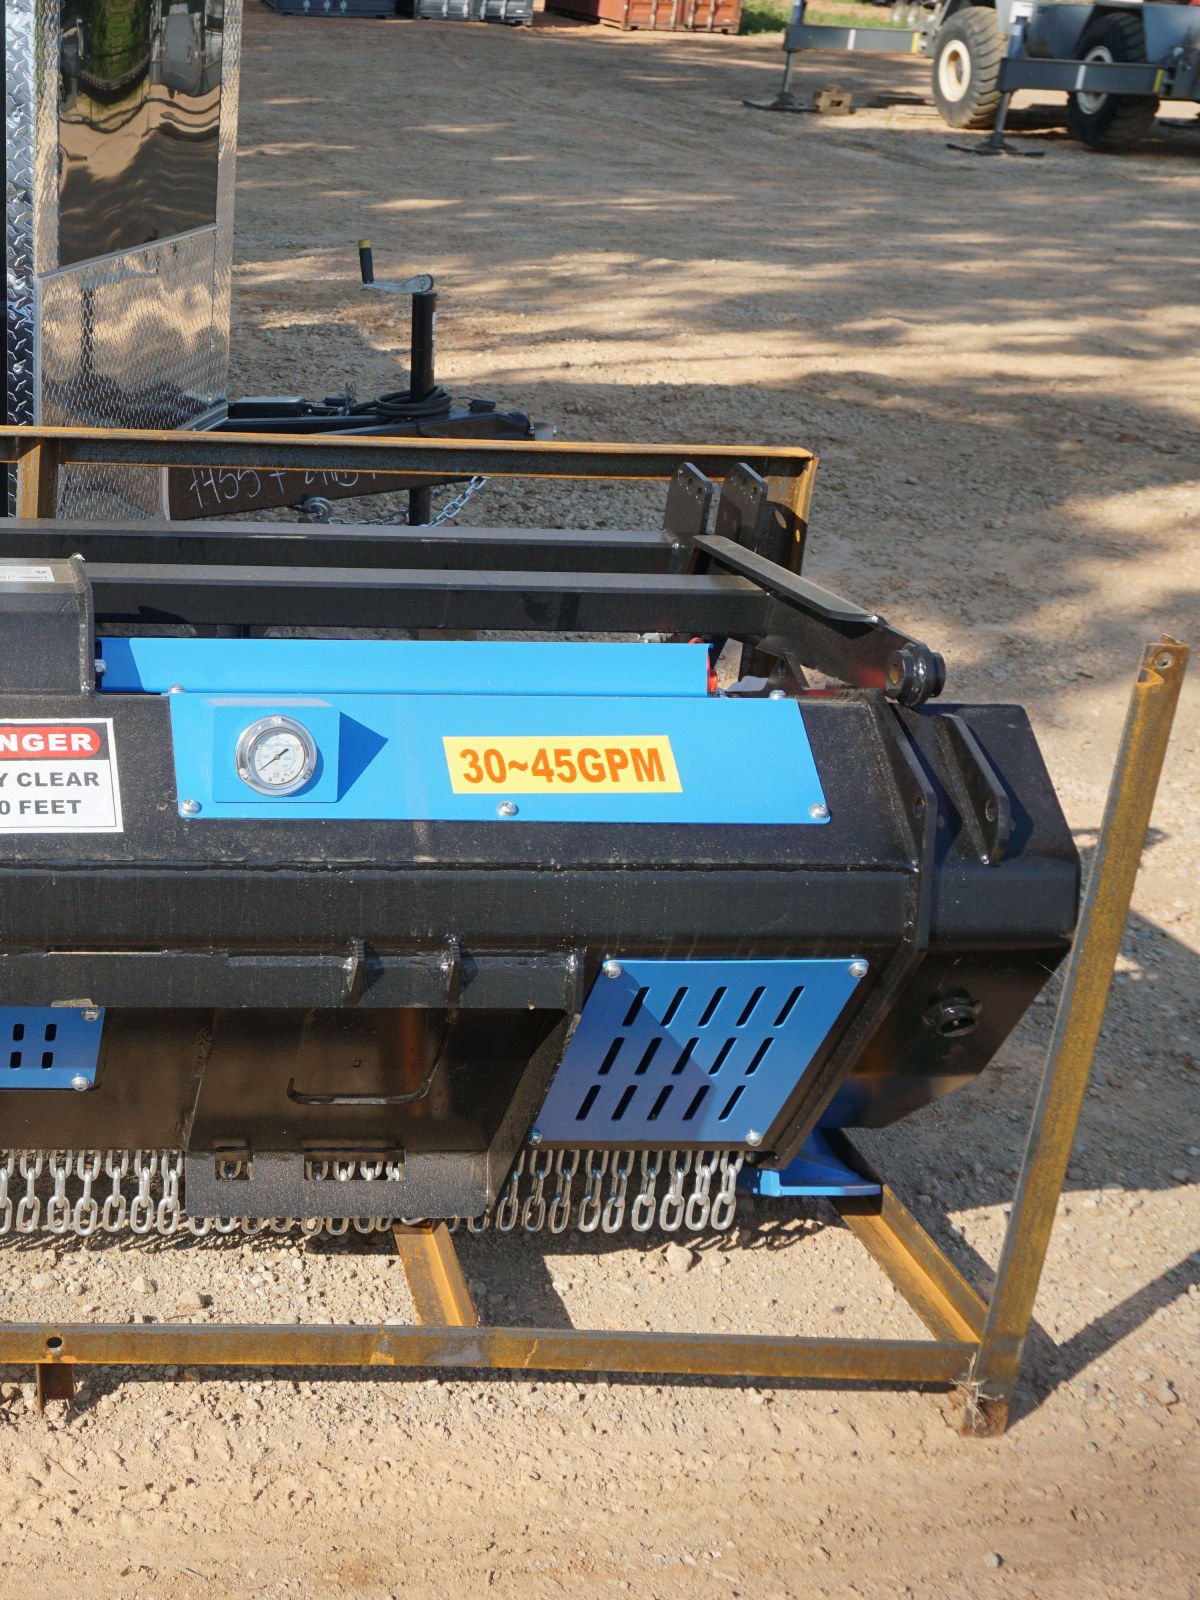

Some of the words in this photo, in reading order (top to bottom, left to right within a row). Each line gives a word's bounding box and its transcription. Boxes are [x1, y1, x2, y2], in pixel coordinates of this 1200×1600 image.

[459, 747, 666, 784] 30~45GPM
[16, 771, 100, 787] CLEAR
[19, 799, 82, 815] FEET
